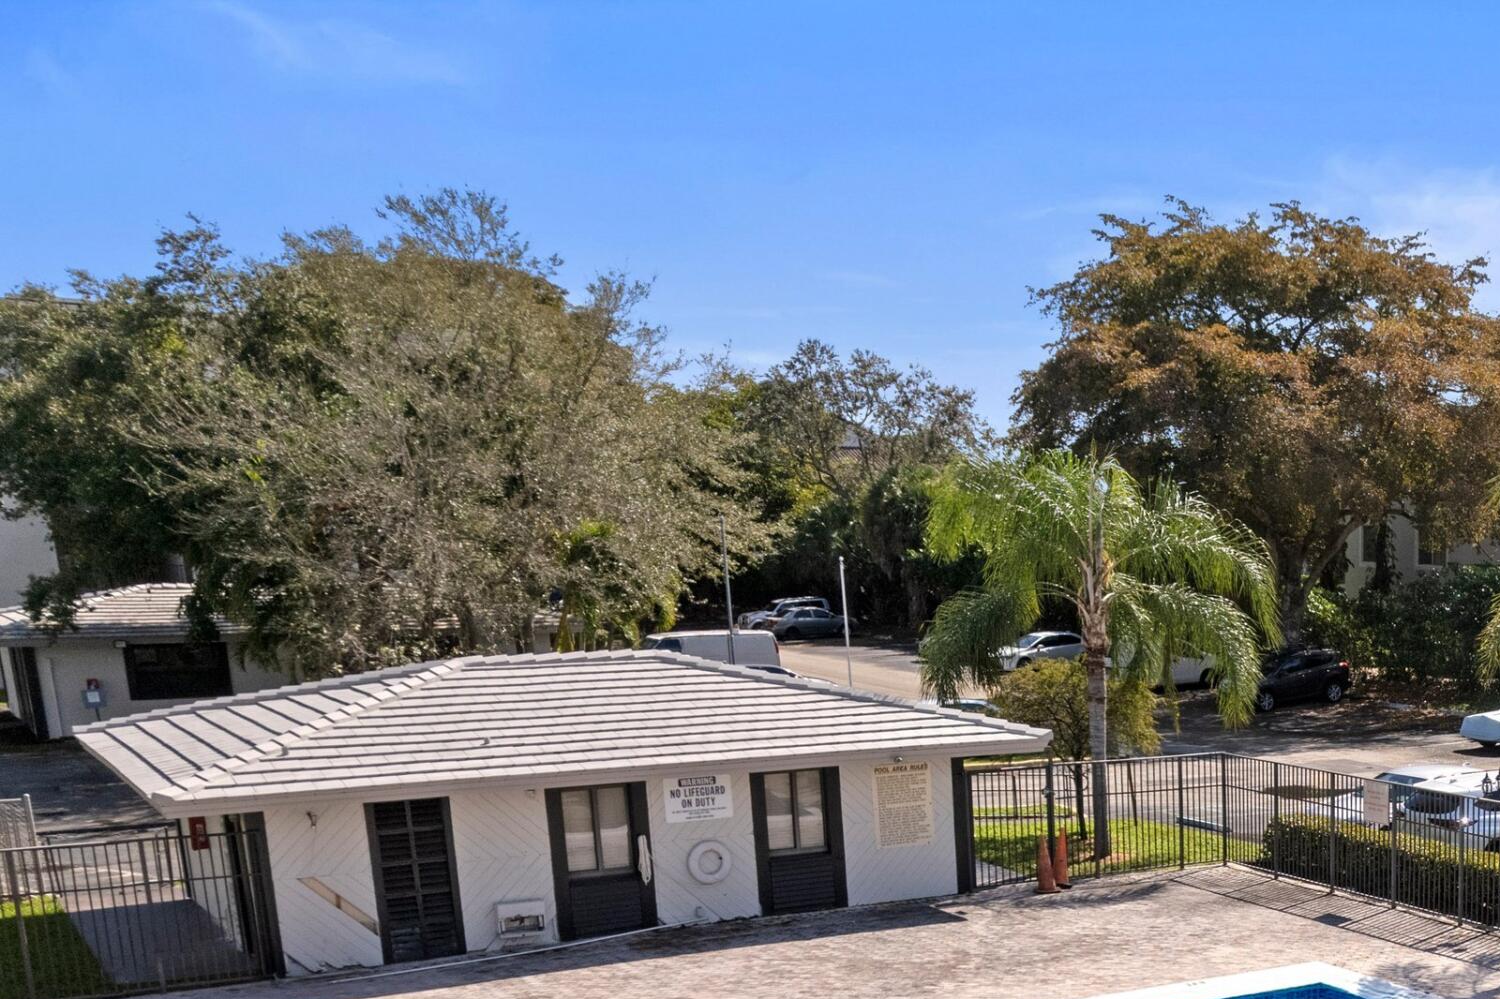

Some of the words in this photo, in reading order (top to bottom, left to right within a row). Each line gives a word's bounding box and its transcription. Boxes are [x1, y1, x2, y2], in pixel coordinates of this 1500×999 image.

[680, 776, 715, 786] WARNING
[670, 788, 682, 799] NO
[684, 785, 726, 798] LIFEGUARD
[681, 798, 693, 809] ON
[695, 797, 716, 808] DUTY
